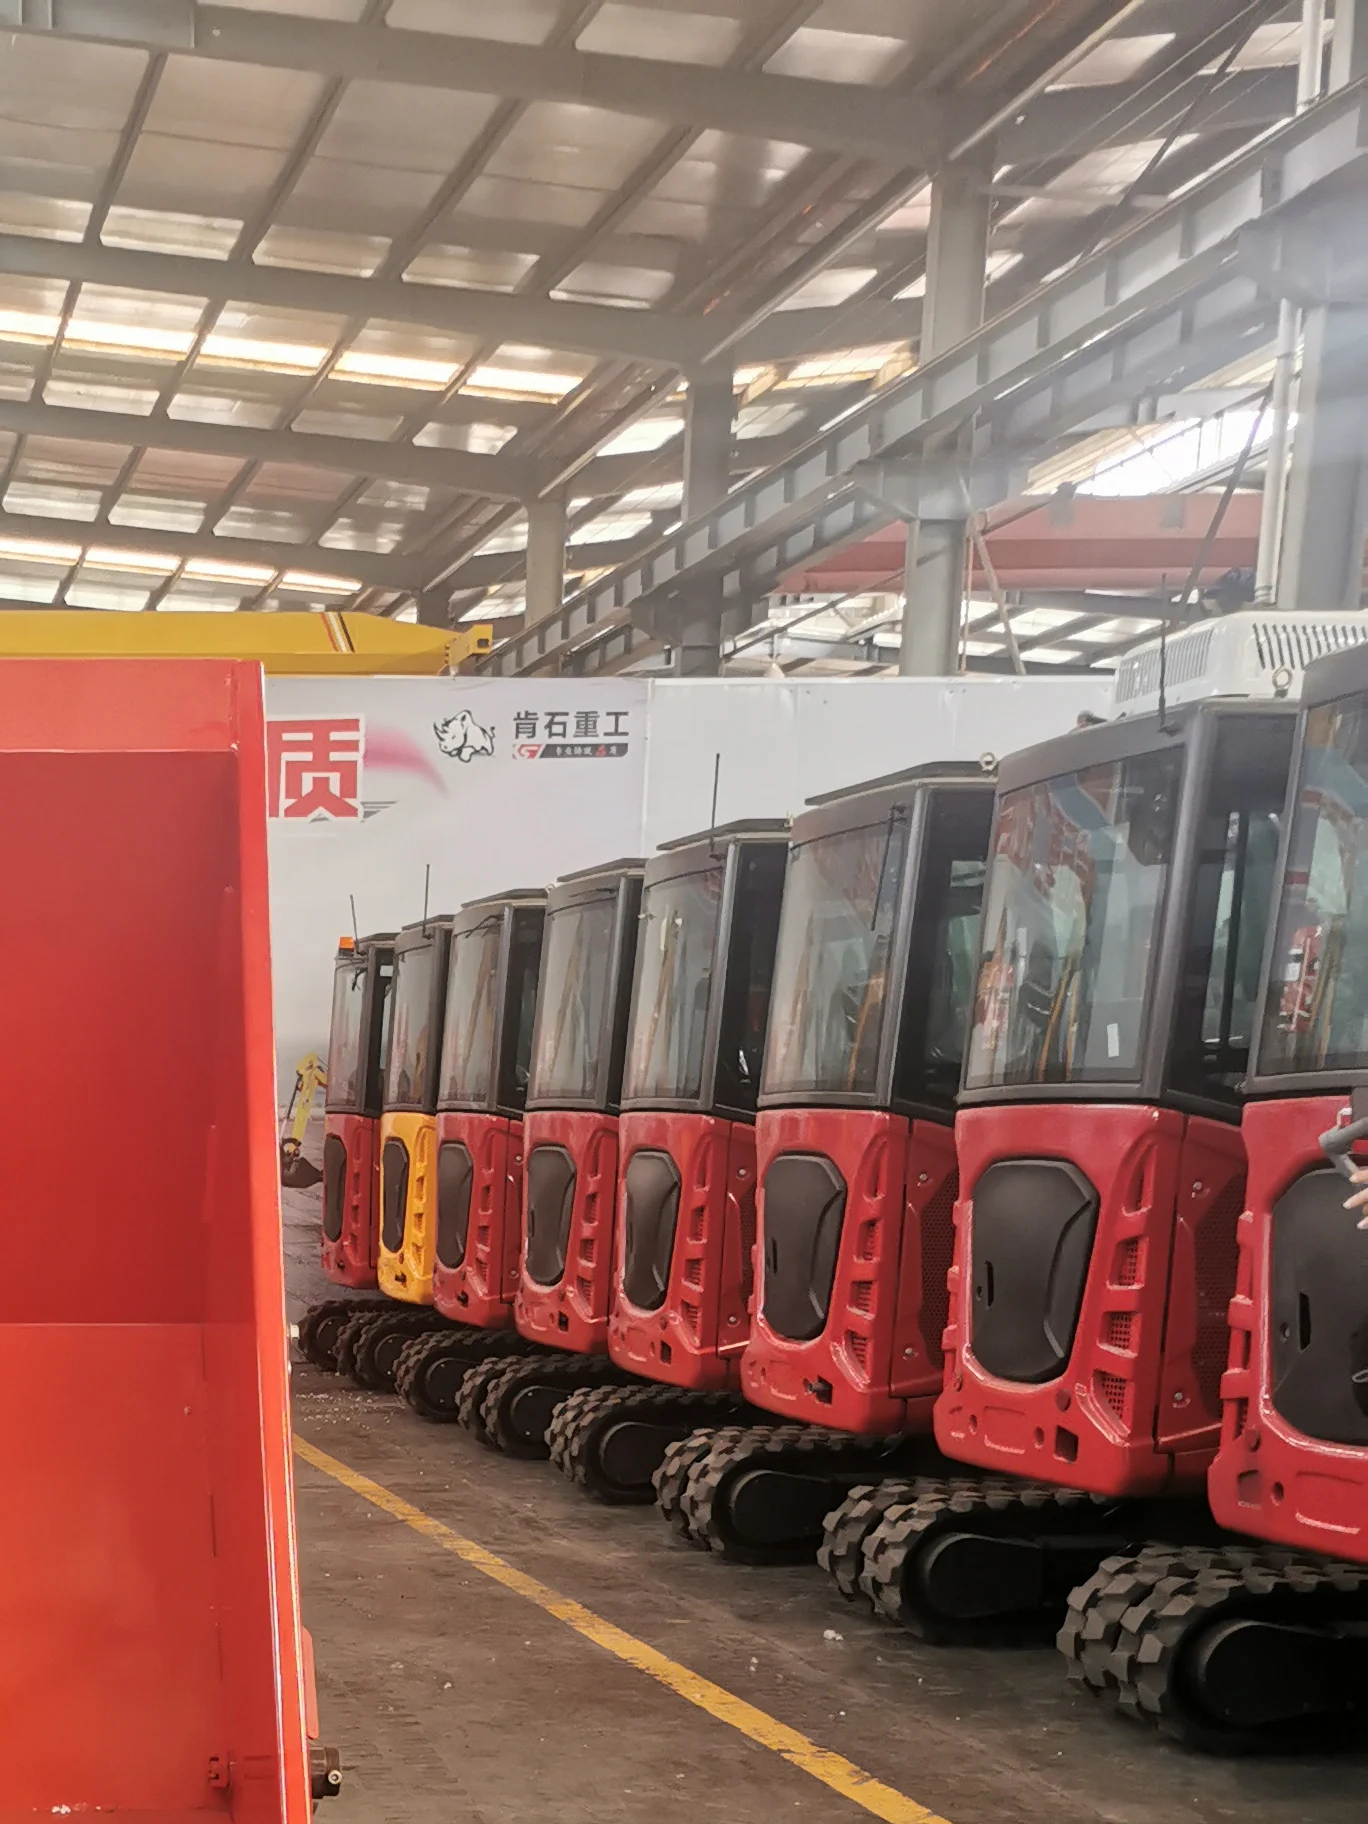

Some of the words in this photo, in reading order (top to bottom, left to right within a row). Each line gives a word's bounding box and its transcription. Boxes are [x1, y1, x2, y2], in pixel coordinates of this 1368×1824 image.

[512, 710, 630, 739] 肯石重工
[265, 717, 361, 820] 质
